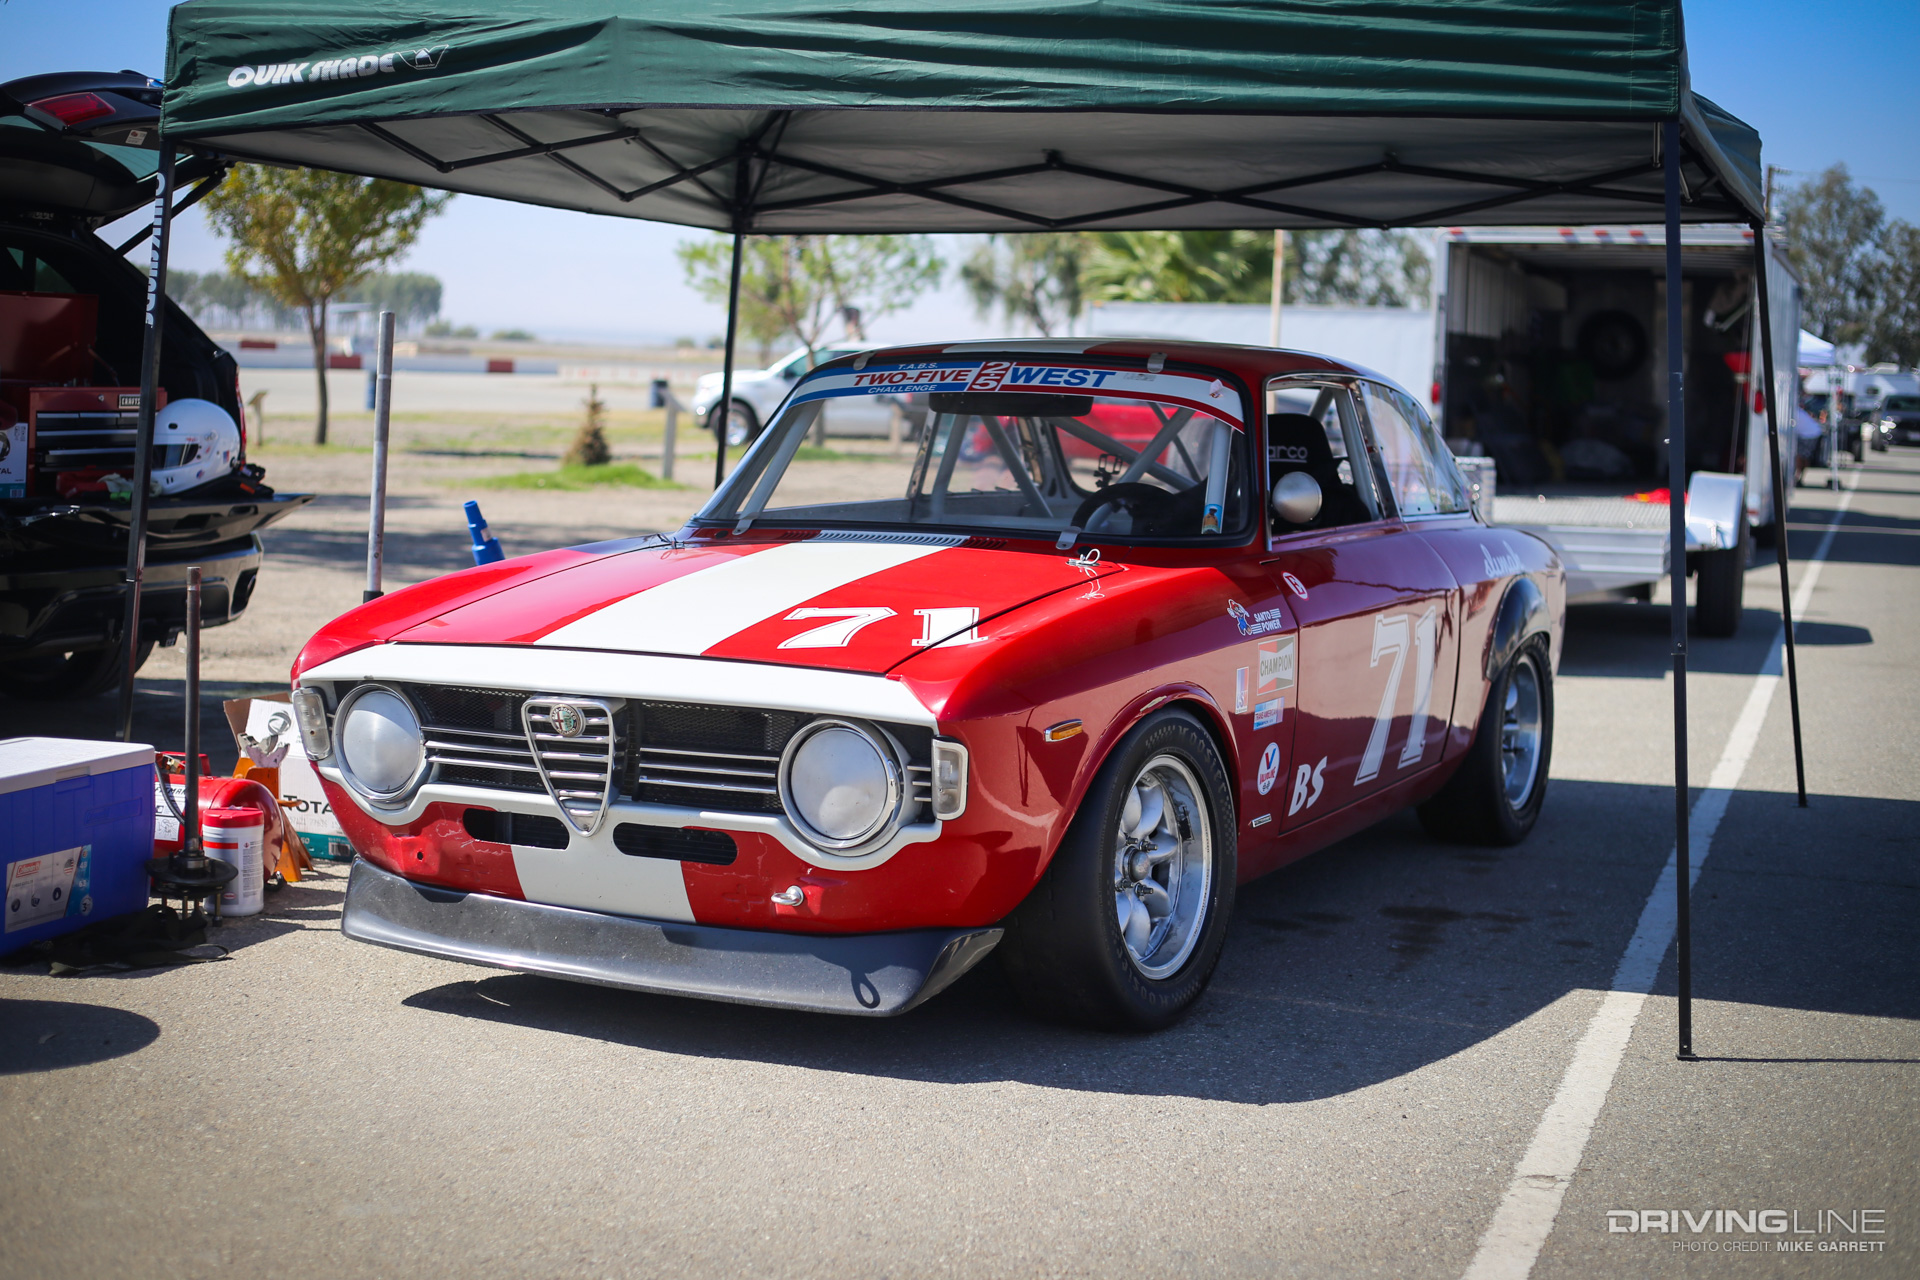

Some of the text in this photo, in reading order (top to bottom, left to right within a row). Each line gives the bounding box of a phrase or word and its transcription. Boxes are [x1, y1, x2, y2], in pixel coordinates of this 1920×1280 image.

[227, 53, 397, 88] QUIK SHADE
[853, 369, 973, 386] TWO-FIVE
[1009, 367, 1117, 388] WEST
[867, 384, 938, 394] CHALLENGE
[777, 606, 989, 650] 71
[1253, 610, 1272, 623] SANTO
[1261, 618, 1282, 633] POWER
[1260, 654, 1292, 677] CHAMPION
[1353, 605, 1437, 787] 71
[1288, 756, 1328, 817] BS
